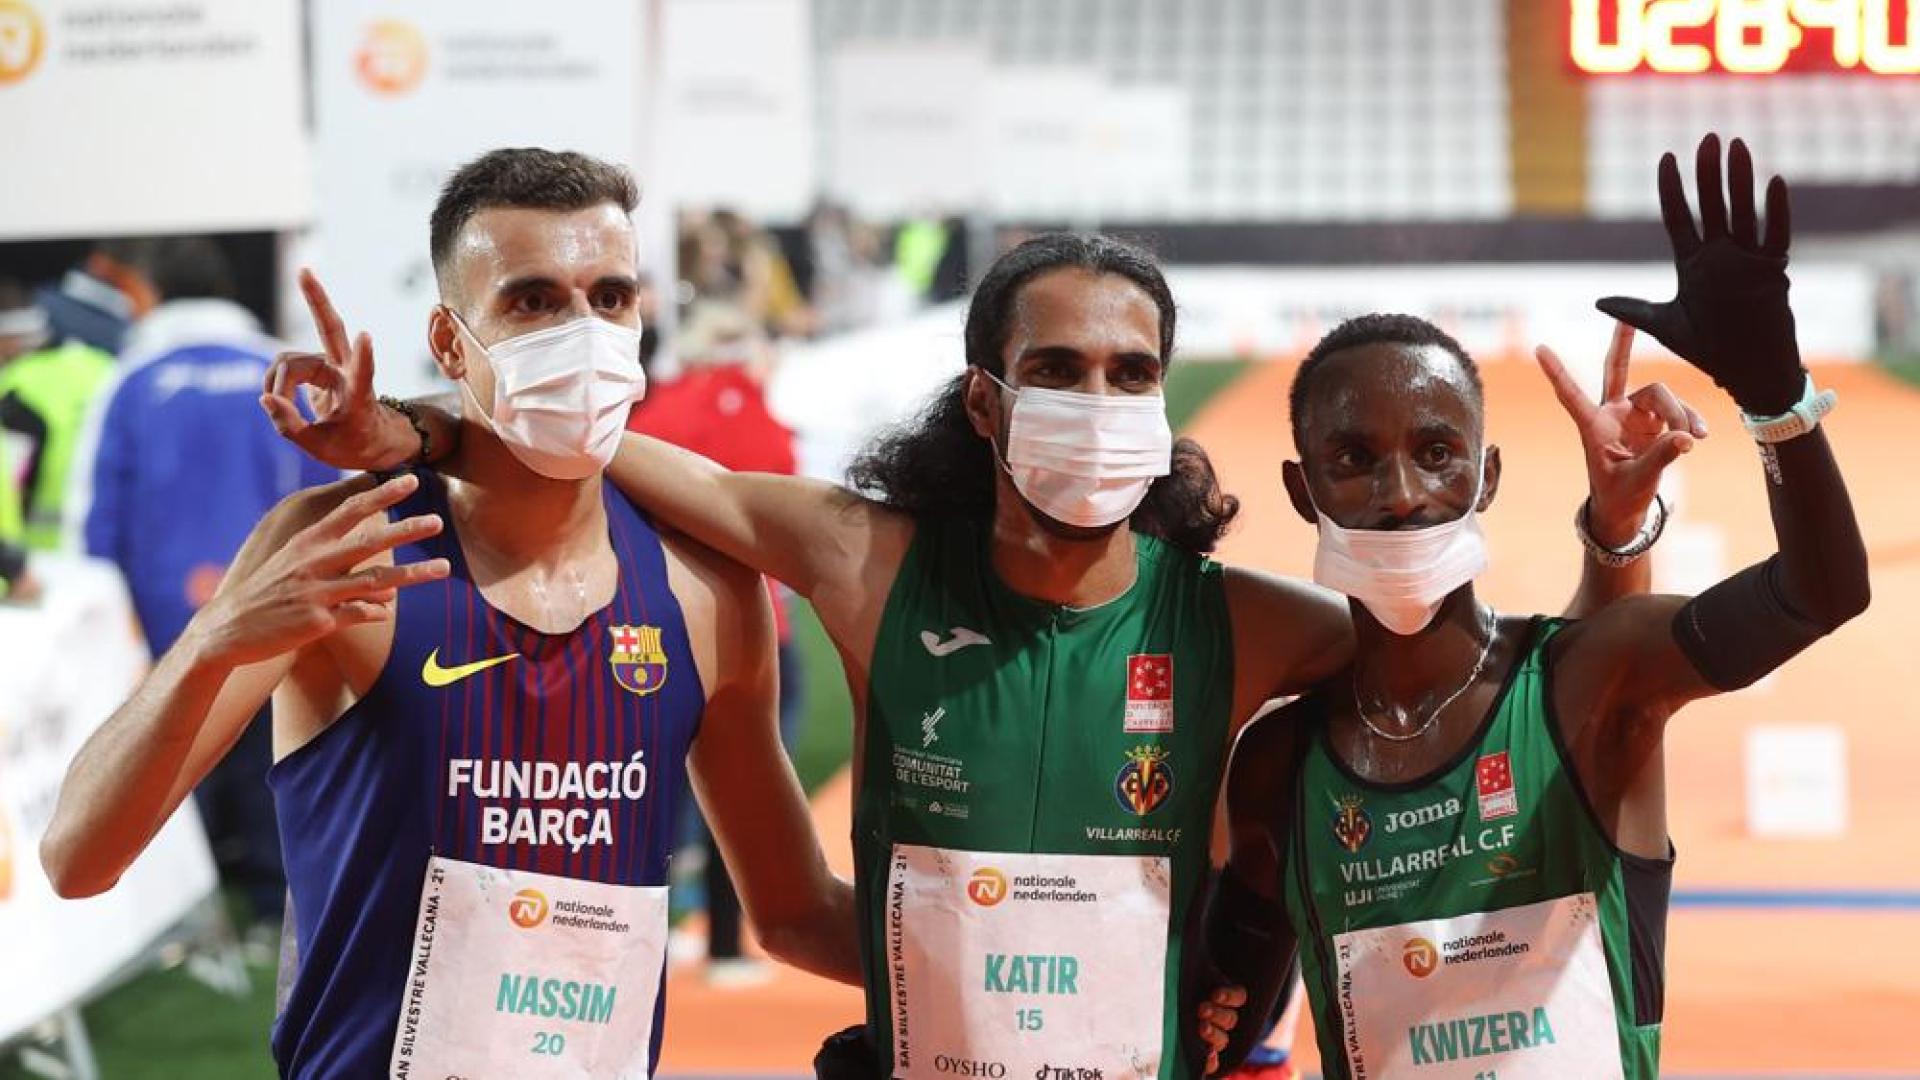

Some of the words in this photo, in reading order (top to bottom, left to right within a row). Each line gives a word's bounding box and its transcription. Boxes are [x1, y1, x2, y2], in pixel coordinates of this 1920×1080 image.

[448, 750, 648, 801] FUNDACIÓ
[481, 806, 614, 854] BARÇA
[1013, 875, 1077, 888] nationale
[1013, 889, 1097, 903] nederlanden
[555, 900, 615, 918] nationale
[552, 914, 631, 933] nederlanden
[1443, 930, 1506, 951] nationale
[1444, 941, 1529, 965] nederlanden
[400, 979, 426, 1056] SILVESTRE
[414, 894, 441, 977] VALLECANA
[431, 868, 445, 884] 21
[984, 954, 1079, 995] KATIR
[496, 972, 617, 1025] NASSIM
[1015, 1008, 1044, 1031] 15
[531, 1031, 565, 1056] 20
[1408, 1006, 1556, 1066] KWIZERA
[900, 1041, 910, 1068] SAN
[934, 1054, 1006, 1079] OYSHO
